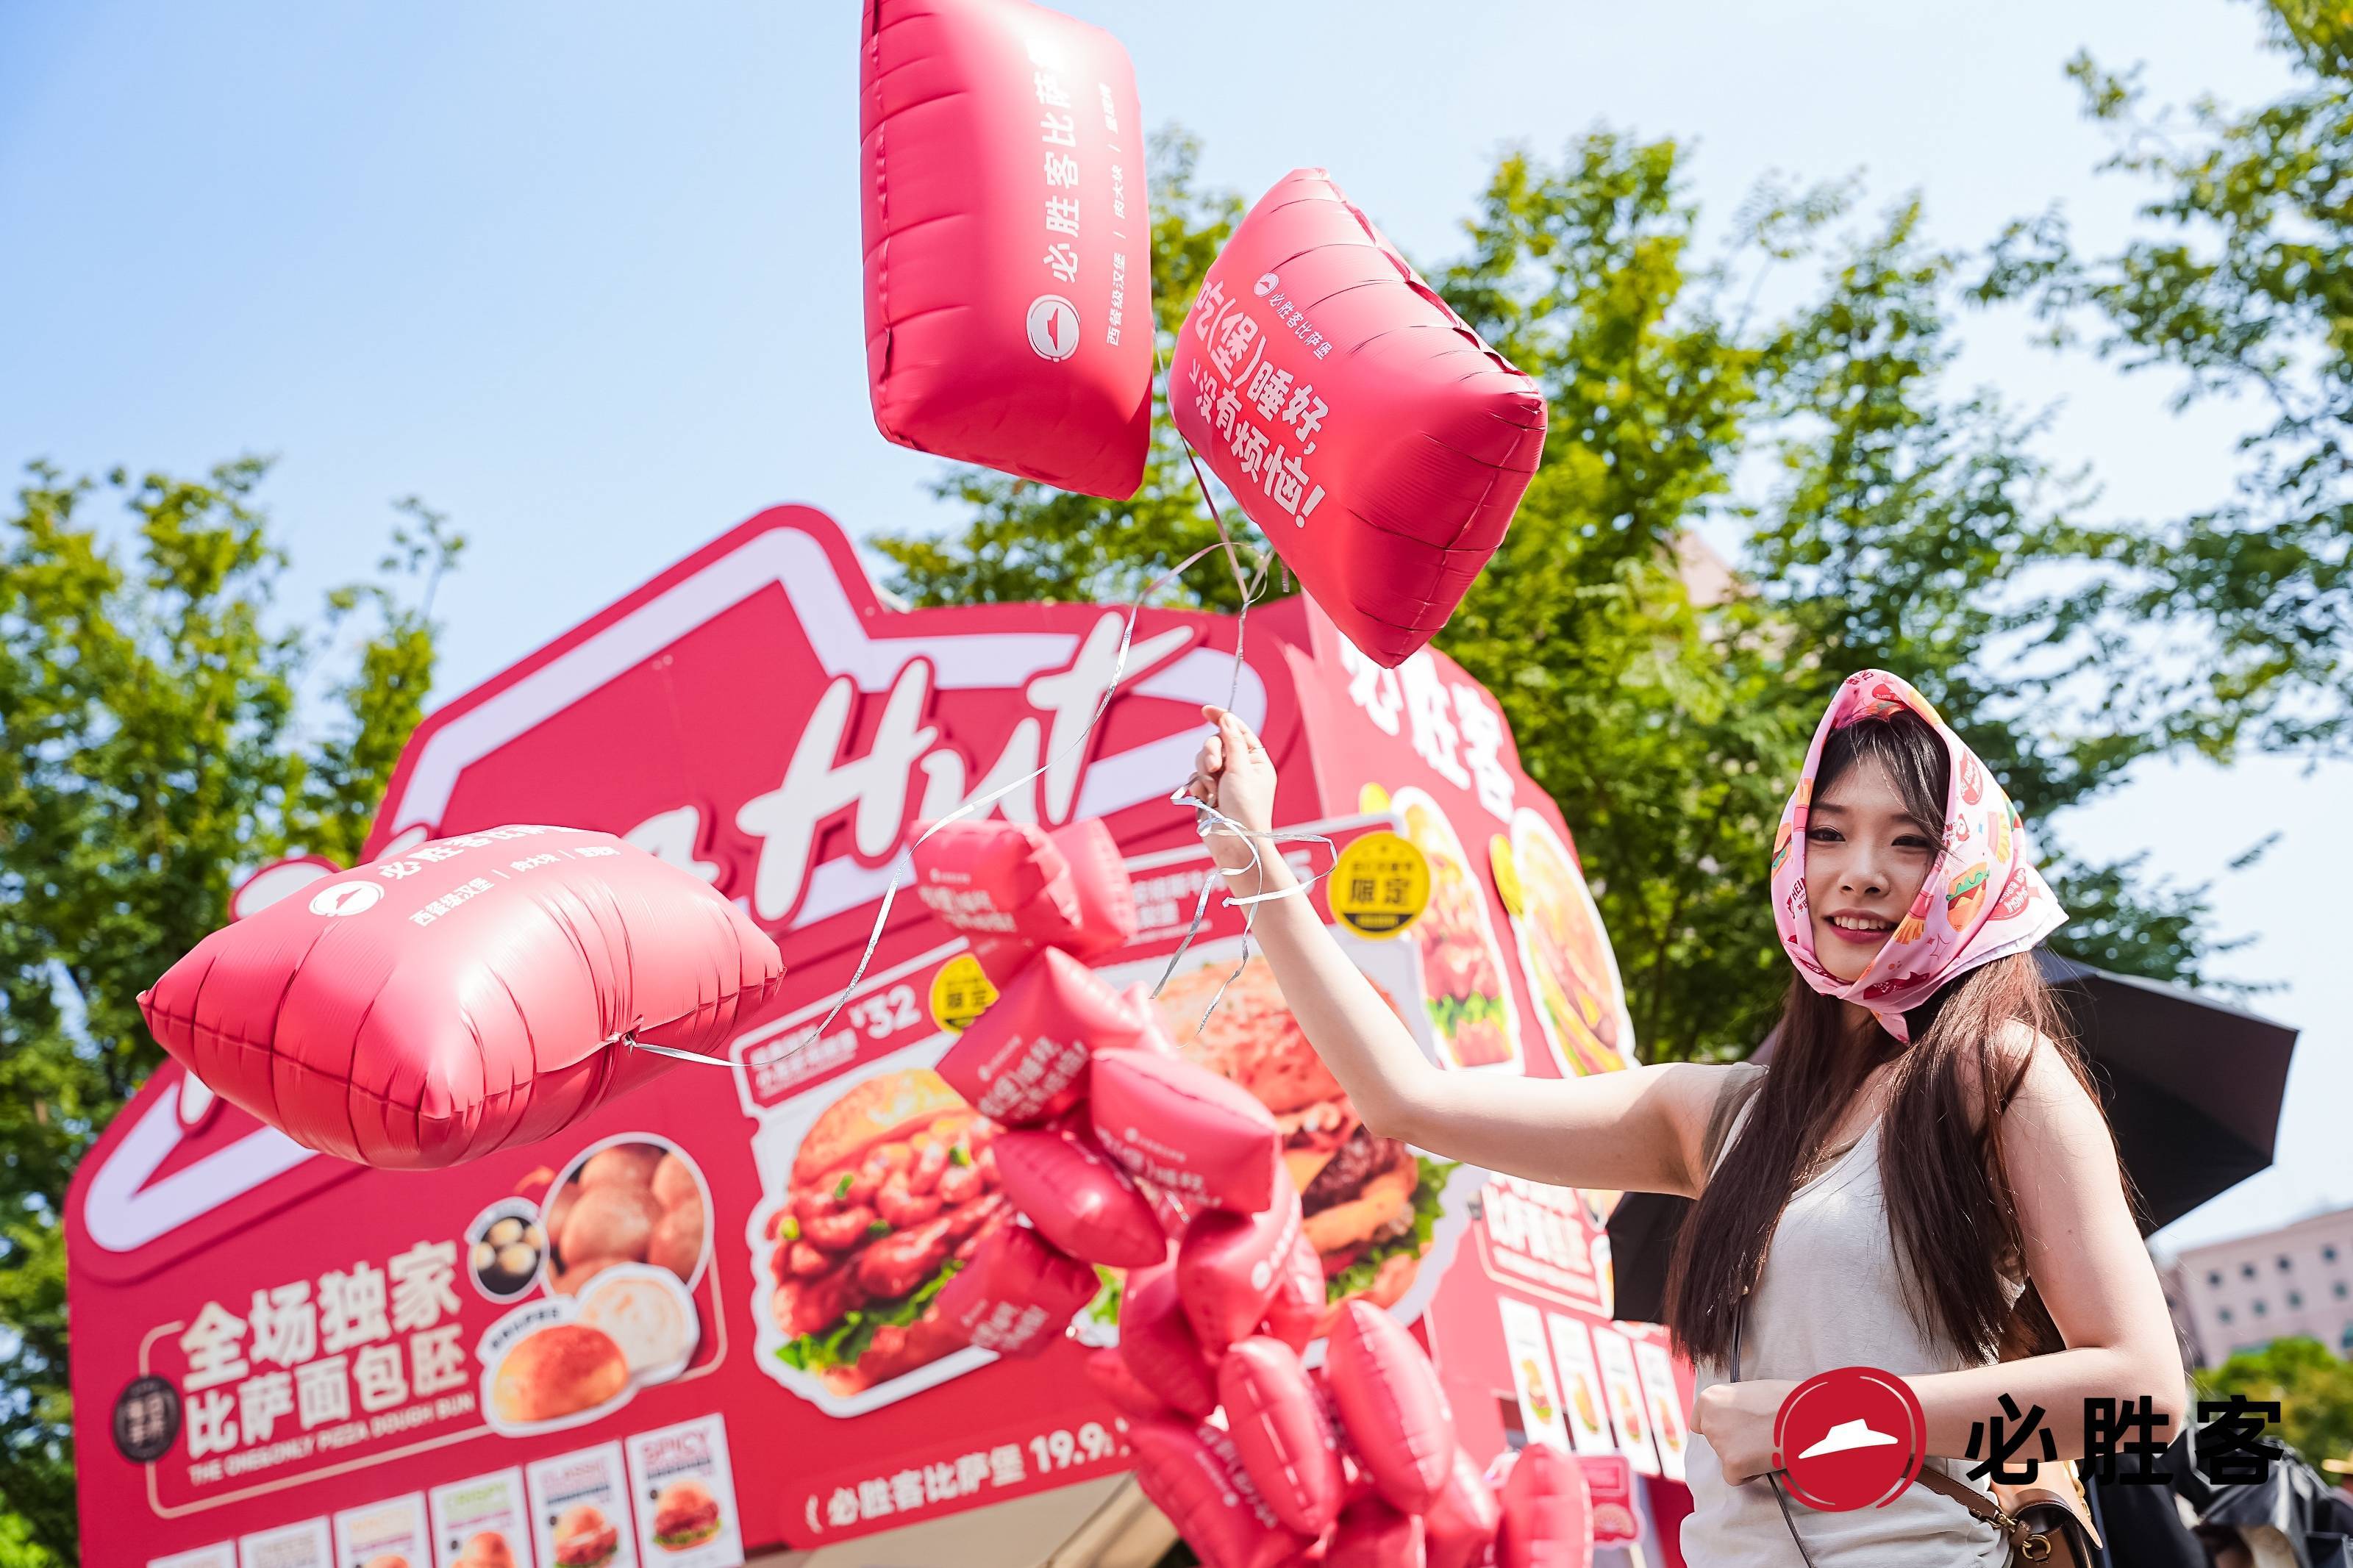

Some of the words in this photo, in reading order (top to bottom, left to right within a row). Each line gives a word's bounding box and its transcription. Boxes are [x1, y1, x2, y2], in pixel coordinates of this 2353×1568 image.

[1028, 46, 1079, 283] 必胜客比萨
[1111, 165, 1125, 218] 肉大块
[1106, 251, 1126, 347] 西餐级汉堡
[1268, 293, 1333, 361] 必胜客比萨堡
[735, 609, 1196, 922] Hut
[179, 1239, 462, 1391] 全场独家
[185, 1323, 468, 1459] 比萨面包胚
